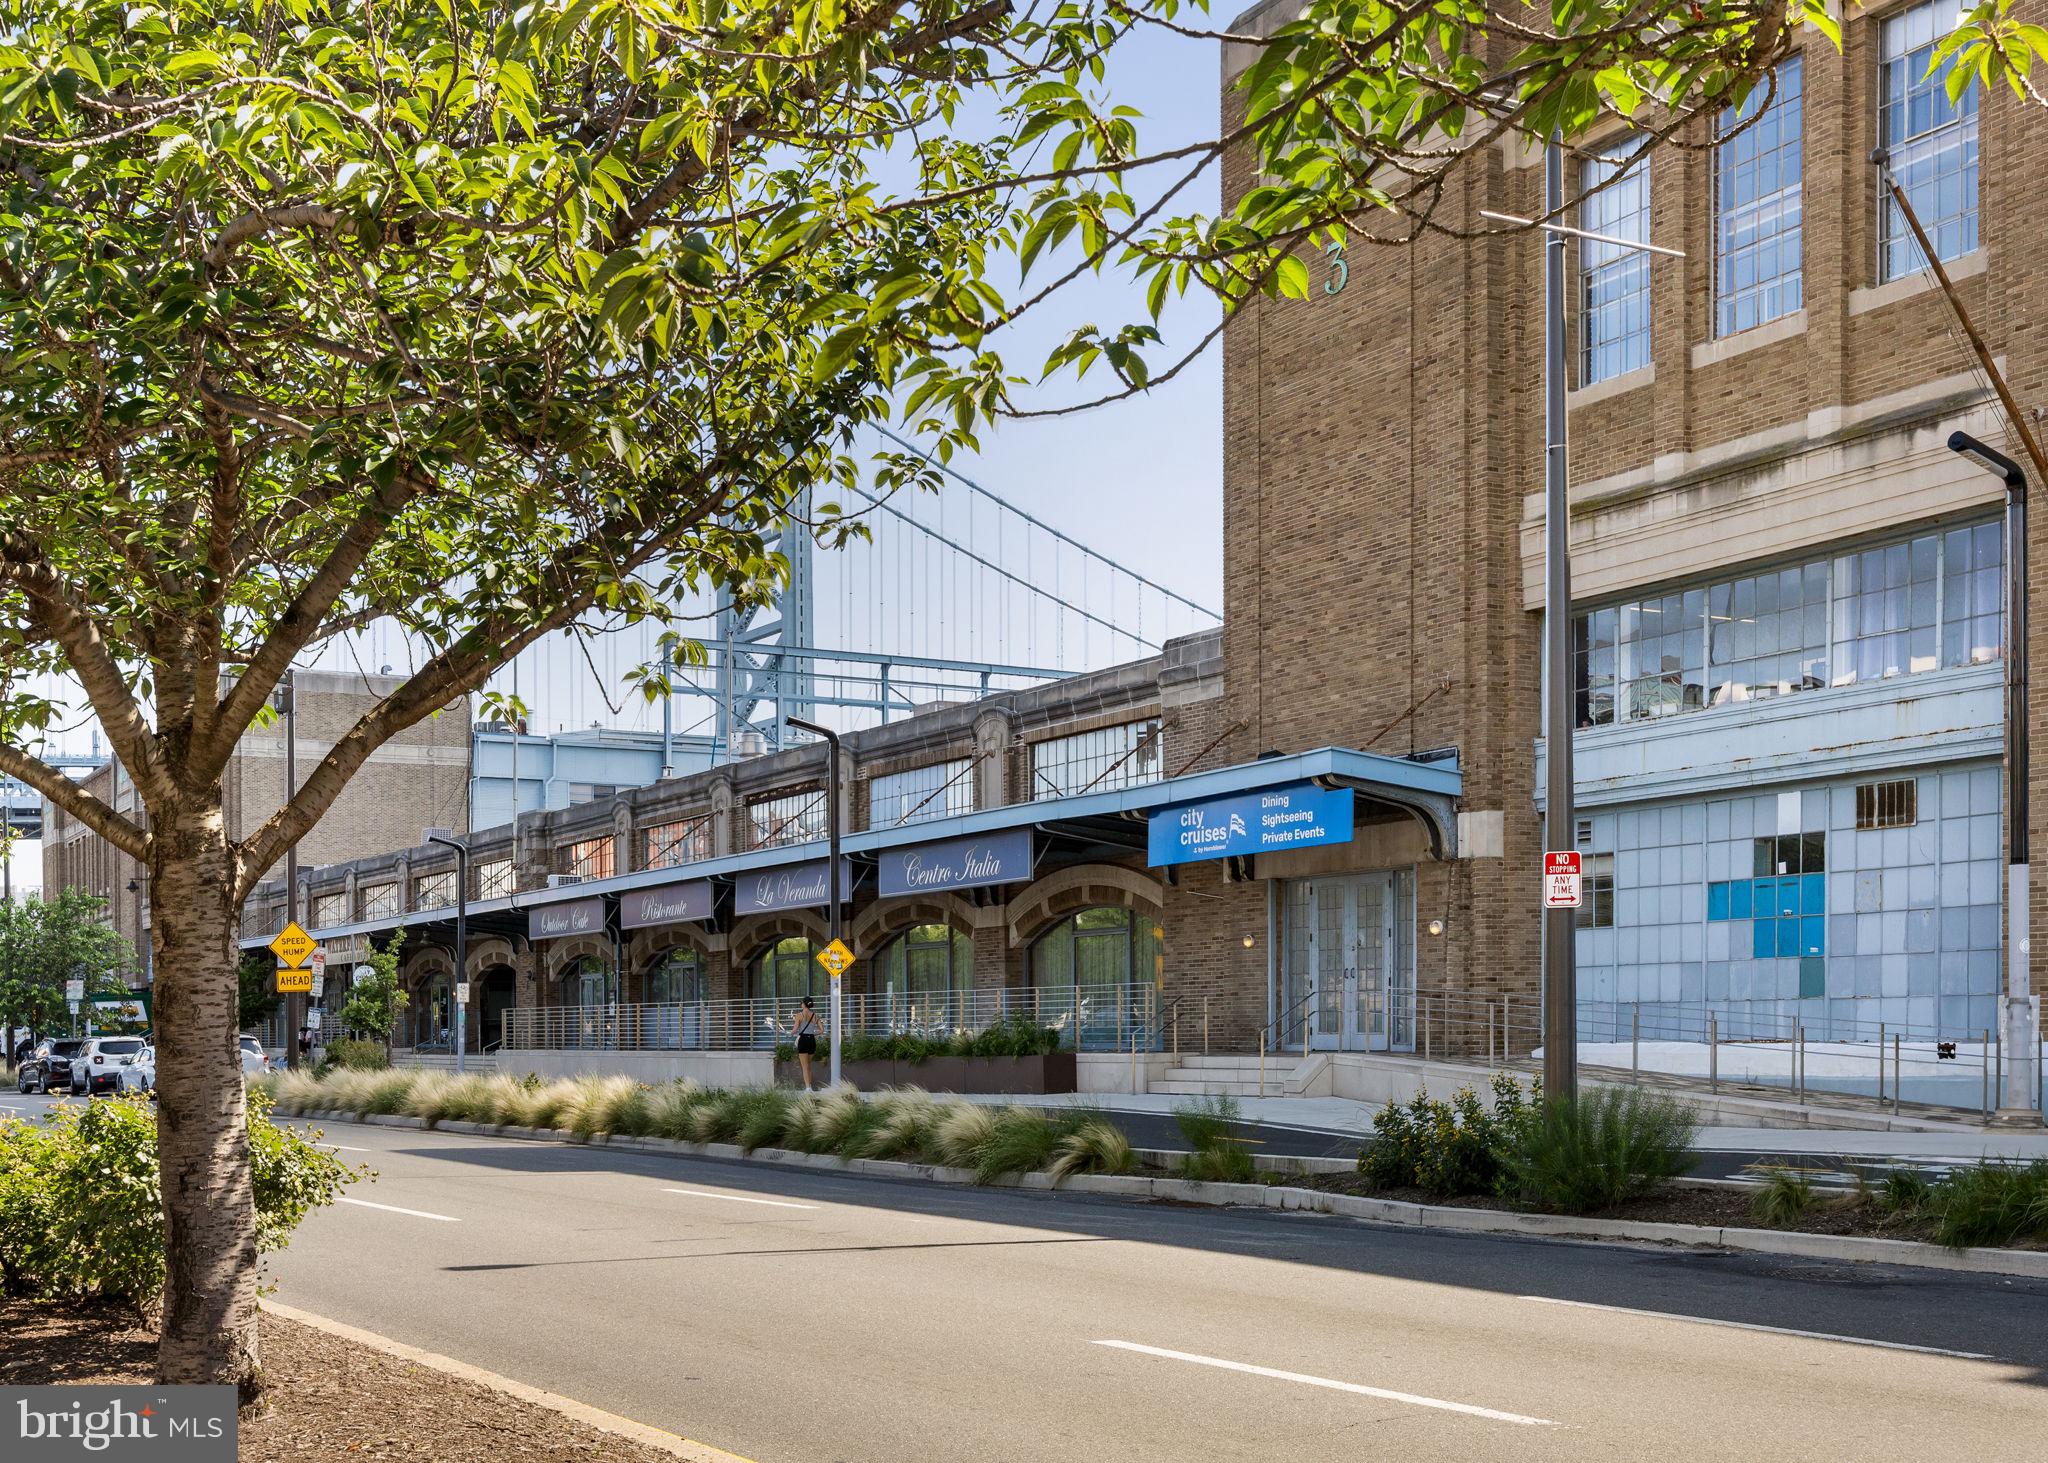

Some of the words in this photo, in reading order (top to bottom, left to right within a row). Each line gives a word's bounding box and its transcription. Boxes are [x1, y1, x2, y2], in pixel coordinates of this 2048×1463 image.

[1324, 242, 1348, 295] 3
[1262, 795, 1289, 808] Dining
[1181, 809, 1204, 828] city
[1262, 810, 1313, 828] Sightseeing
[1181, 826, 1227, 846] cruises
[1262, 829, 1293, 844] Private
[1294, 826, 1325, 840] Events
[904, 852, 951, 887] Centro
[955, 844, 1002, 881] Italia
[1556, 853, 1569, 864] NO
[1549, 865, 1577, 874] STOPPING
[754, 875, 774, 907] La
[778, 868, 827, 904] Veranda
[1554, 876, 1571, 885] ANY
[1552, 886, 1573, 894] TIME
[641, 895, 688, 920] Ristorante
[541, 911, 569, 933] Outdoor
[281, 937, 306, 945] SPEED
[283, 948, 305, 956] HUMP
[280, 975, 310, 986] AHEAD
